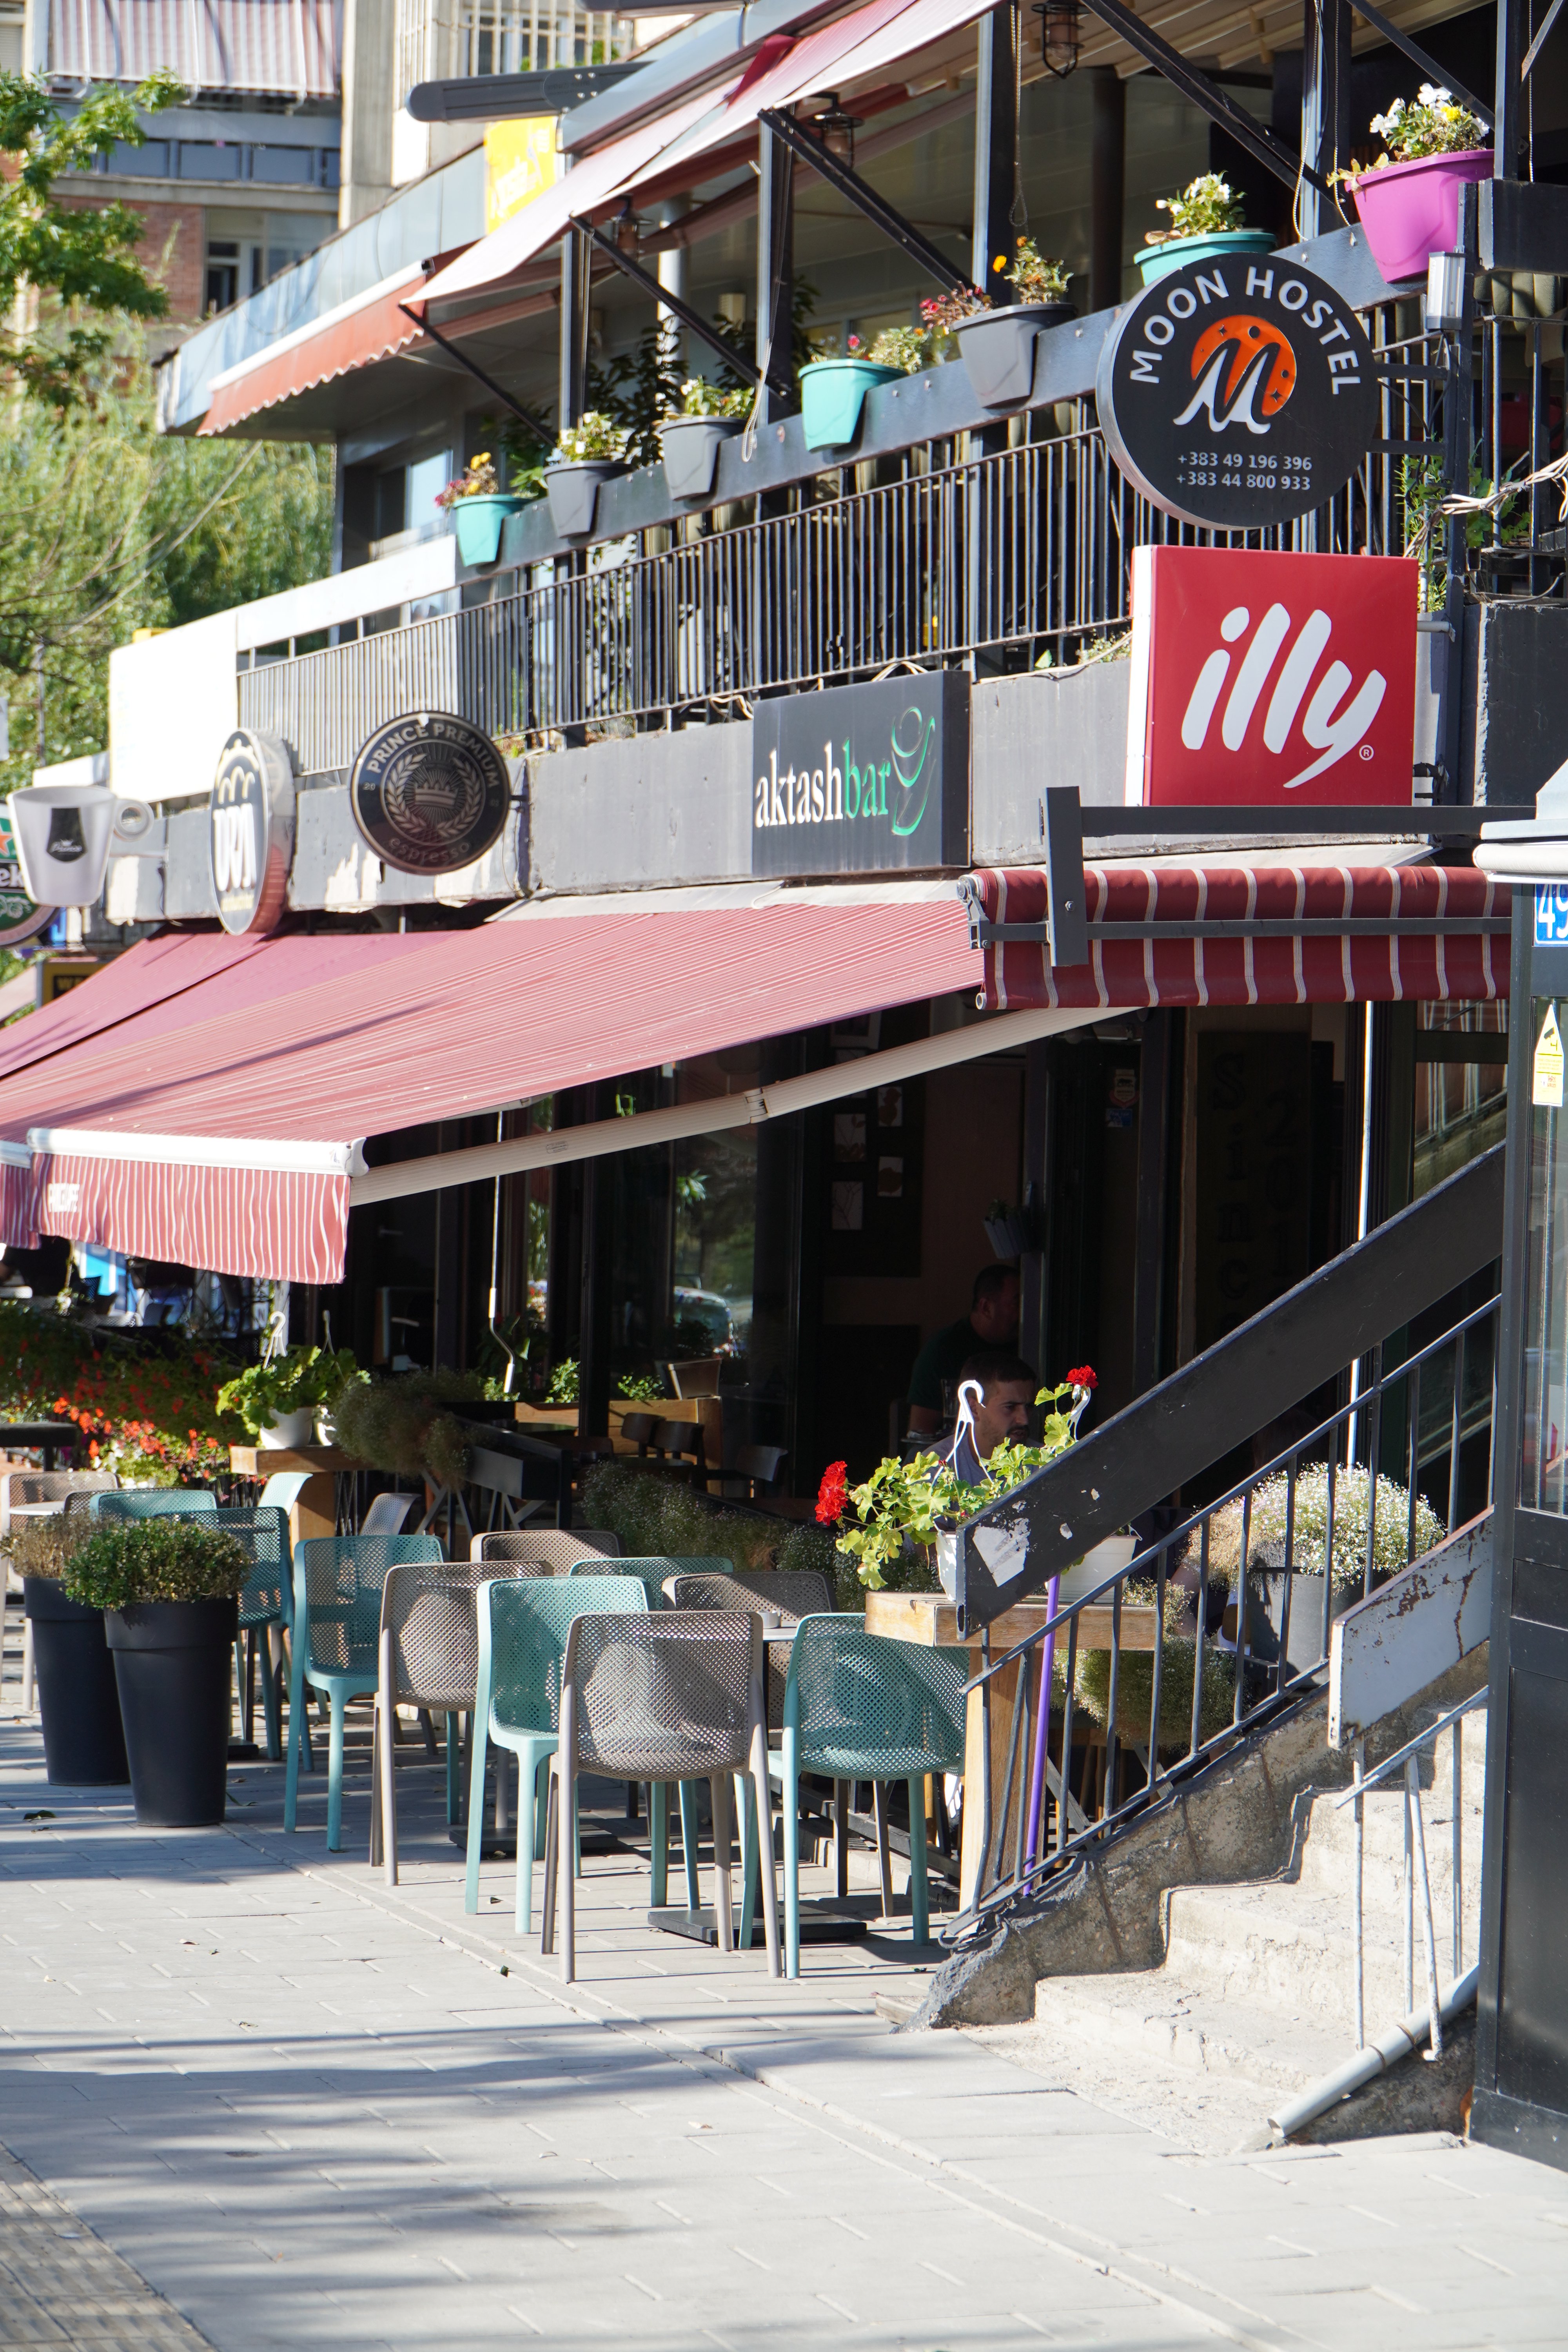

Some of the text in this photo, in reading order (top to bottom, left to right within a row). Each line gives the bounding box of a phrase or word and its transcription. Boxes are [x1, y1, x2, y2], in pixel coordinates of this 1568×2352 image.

[1129, 266, 1361, 395] MOON HOSTEL
[1176, 471, 1310, 490] +383 44 800 933
[1178, 452, 1312, 470] +383 49 196 396
[1181, 603, 1387, 788] illy
[367, 723, 500, 788] PRINCE PREMIUM
[755, 737, 891, 828] aktashbar
[389, 838, 470, 863] espresso
